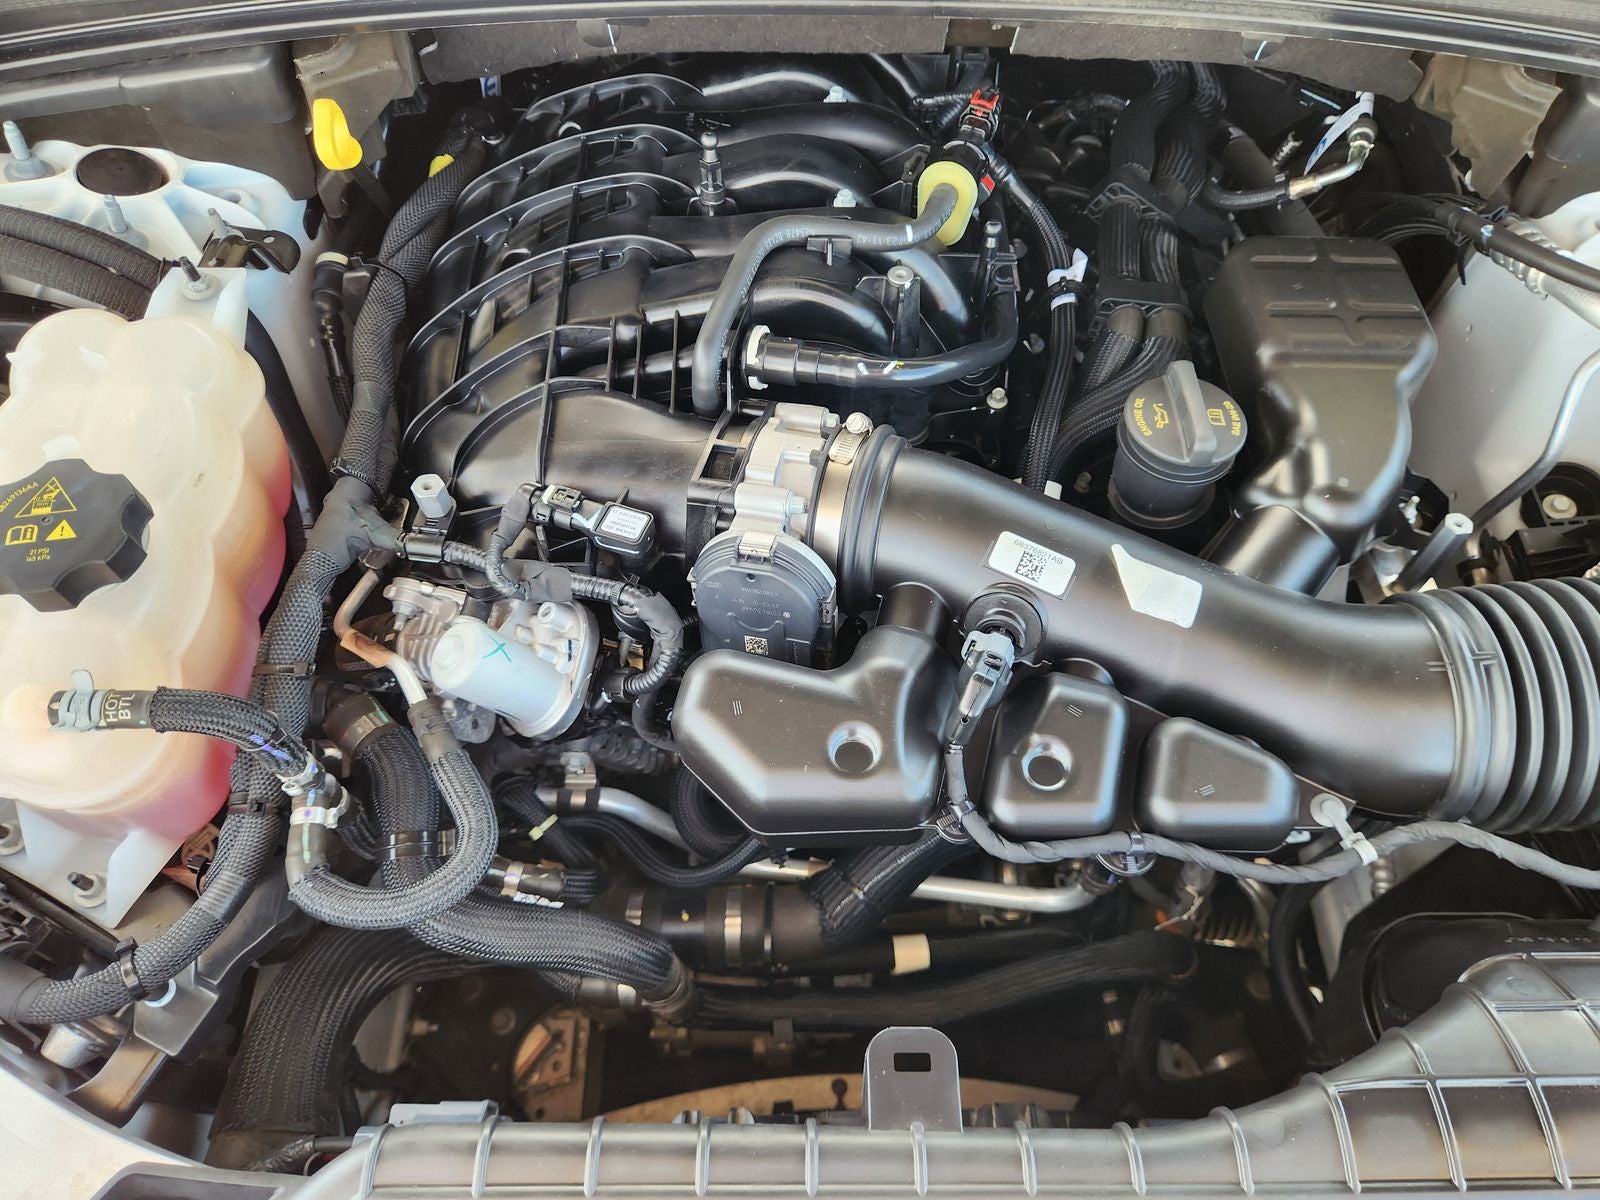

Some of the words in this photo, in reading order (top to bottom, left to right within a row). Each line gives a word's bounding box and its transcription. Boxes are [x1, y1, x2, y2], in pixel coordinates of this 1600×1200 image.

[1133, 398, 1145, 409] OIL
[1133, 409, 1153, 437] ENGINE
[1231, 420, 1241, 437] SAE
[38, 548, 49, 556] PSI
[1013, 540, 1064, 564] 68376821AB
[105, 693, 120, 722] HOT
[118, 693, 135, 719] BTL
